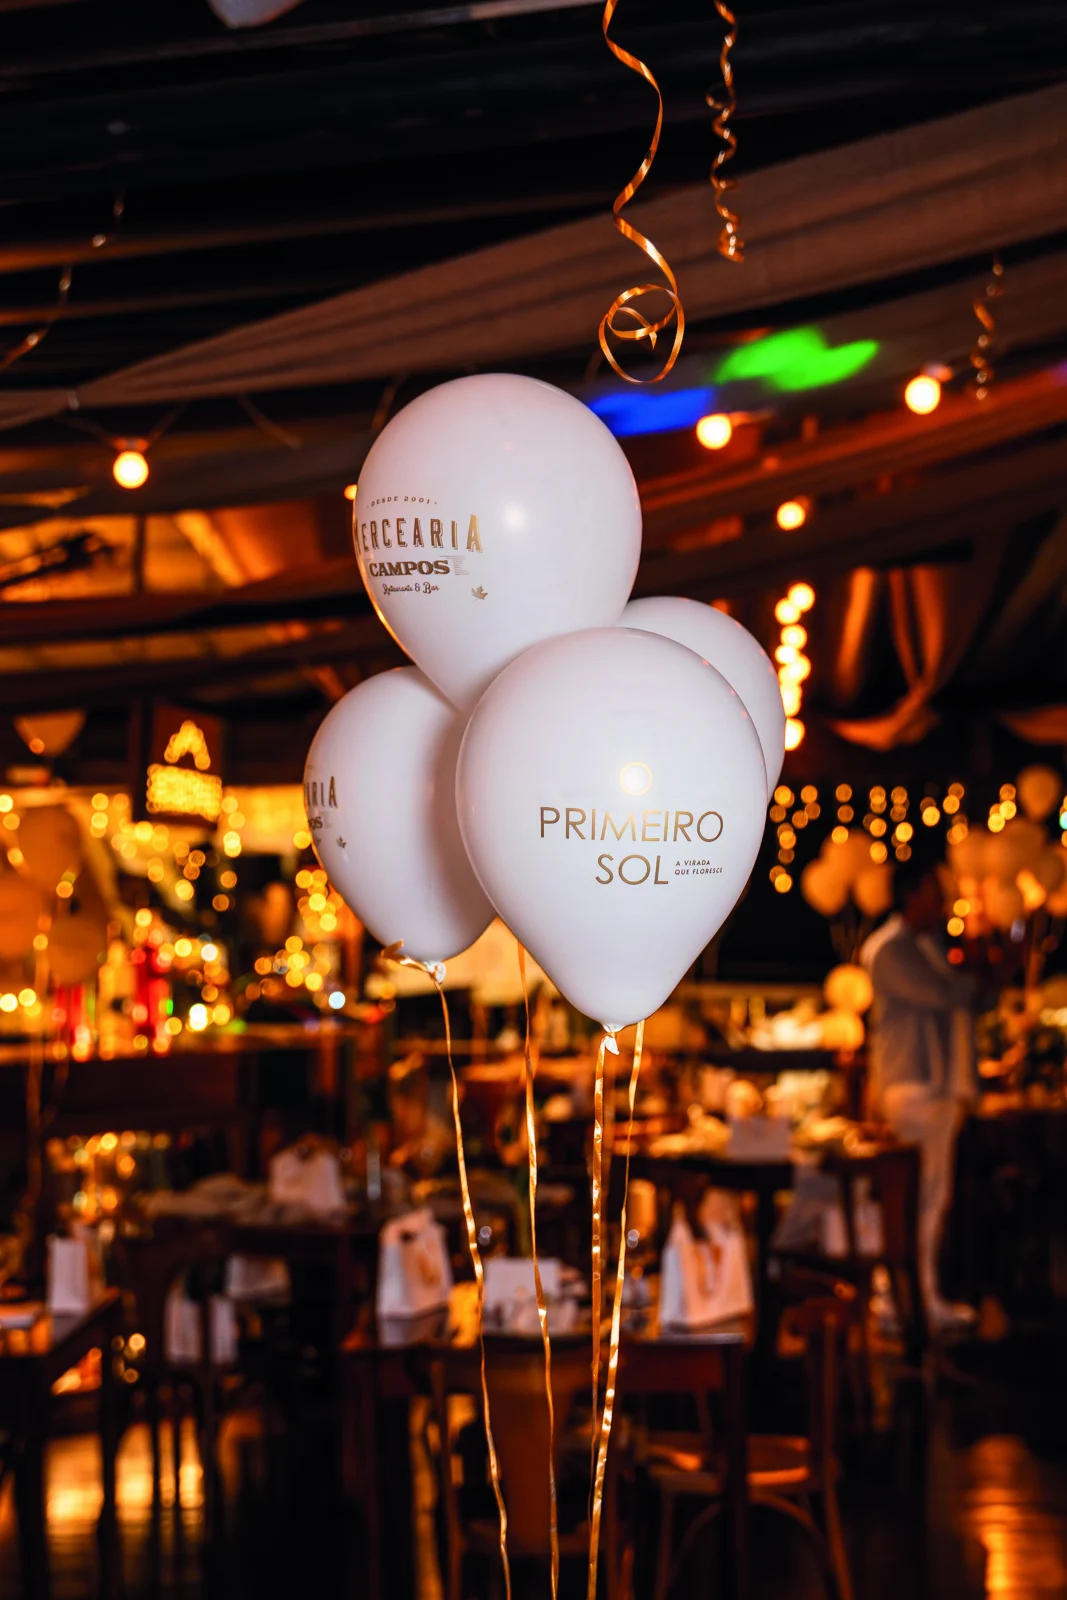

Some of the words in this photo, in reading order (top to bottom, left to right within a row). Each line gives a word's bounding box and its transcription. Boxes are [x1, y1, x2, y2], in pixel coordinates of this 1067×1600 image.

[371, 496, 398, 507] DESDE
[369, 560, 450, 577] CAMPOS
[415, 582, 420, 592] &
[423, 581, 439, 594] Bar
[540, 806, 724, 842] PRIMEIRO
[595, 853, 669, 885] SOL
